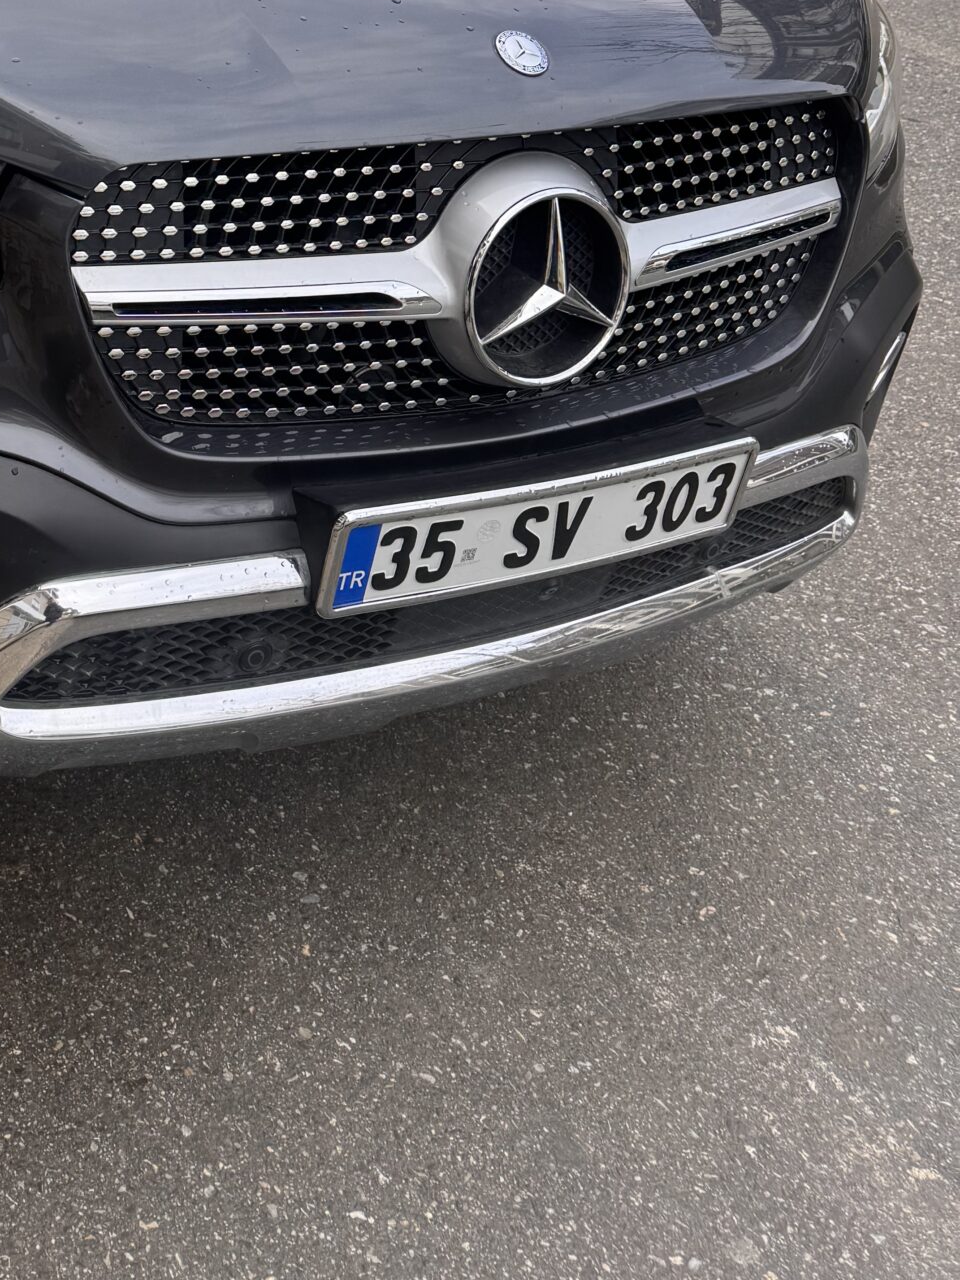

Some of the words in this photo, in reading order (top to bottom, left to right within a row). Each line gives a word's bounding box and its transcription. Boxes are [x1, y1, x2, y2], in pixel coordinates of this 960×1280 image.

[371, 519, 465, 591] 35
[503, 496, 594, 569] SV
[625, 462, 737, 542] 303
[339, 570, 366, 591] TR
